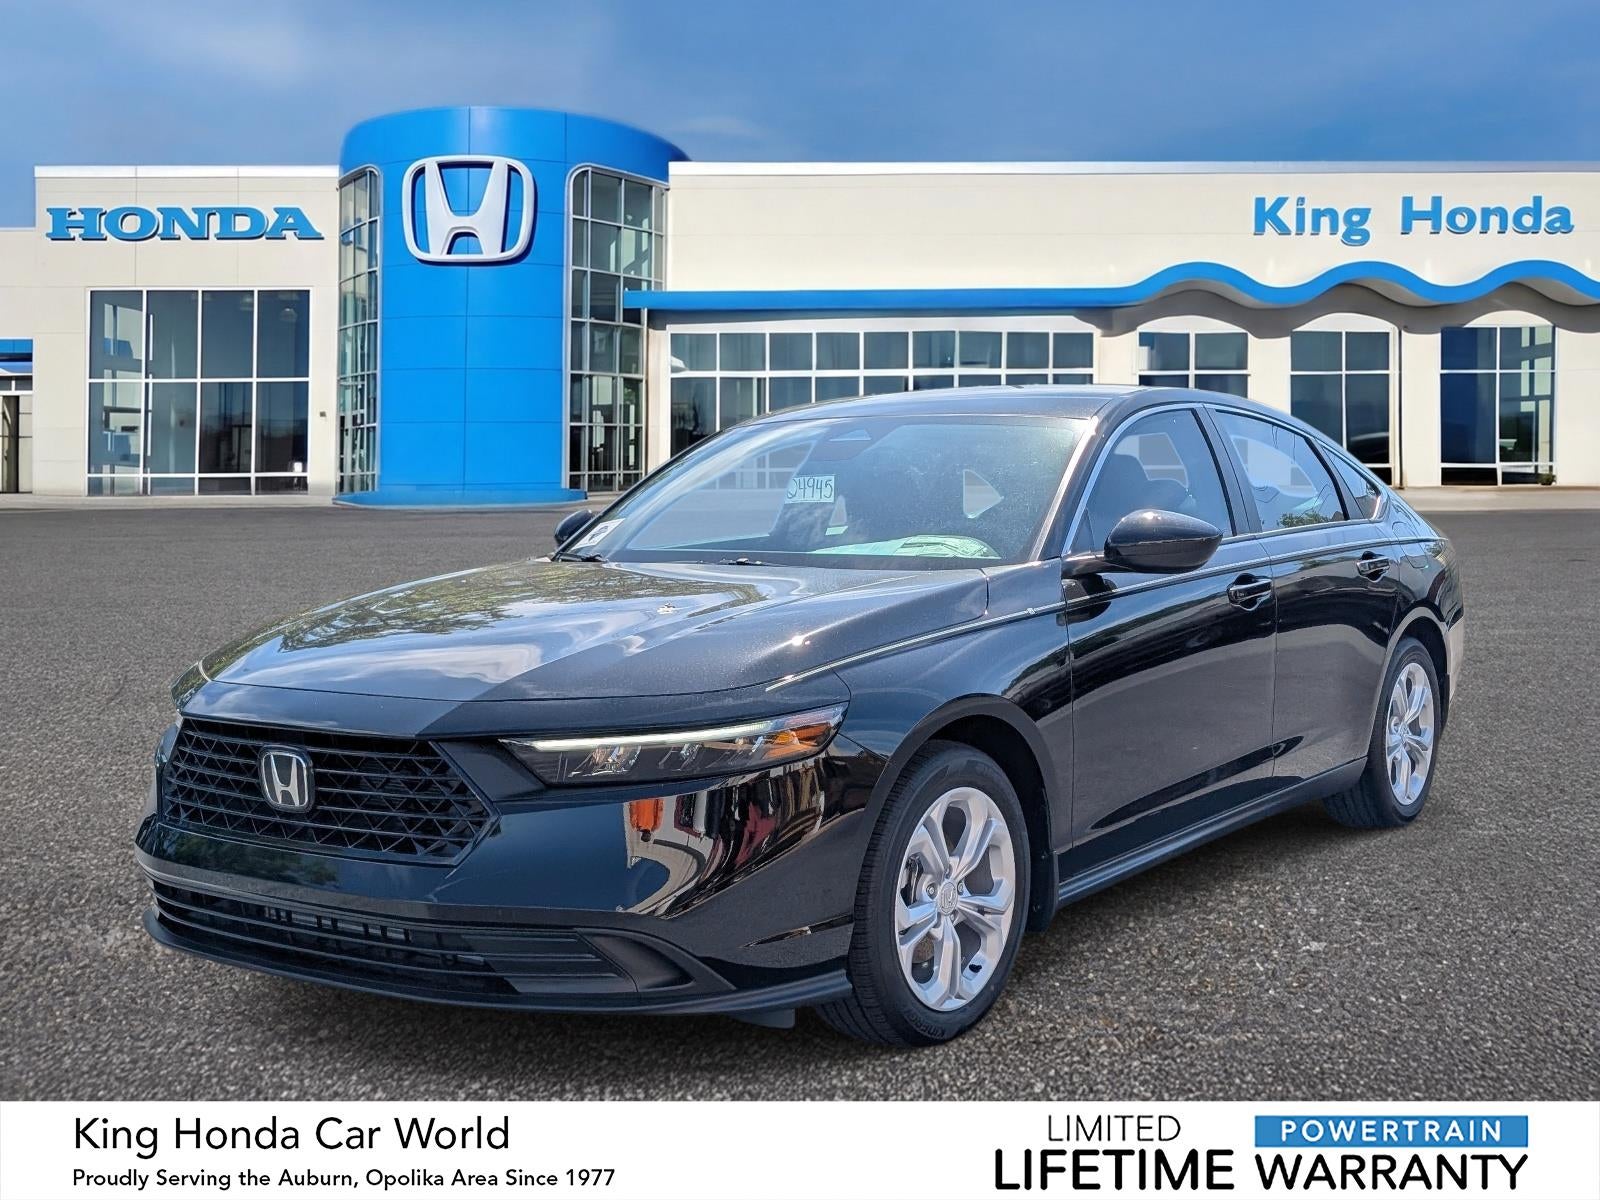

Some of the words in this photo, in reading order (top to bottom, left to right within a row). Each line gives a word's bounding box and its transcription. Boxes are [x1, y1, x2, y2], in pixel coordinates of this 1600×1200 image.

[46, 206, 324, 241] HONDA
[1253, 195, 1371, 245] King
[1401, 195, 1574, 235] Honda
